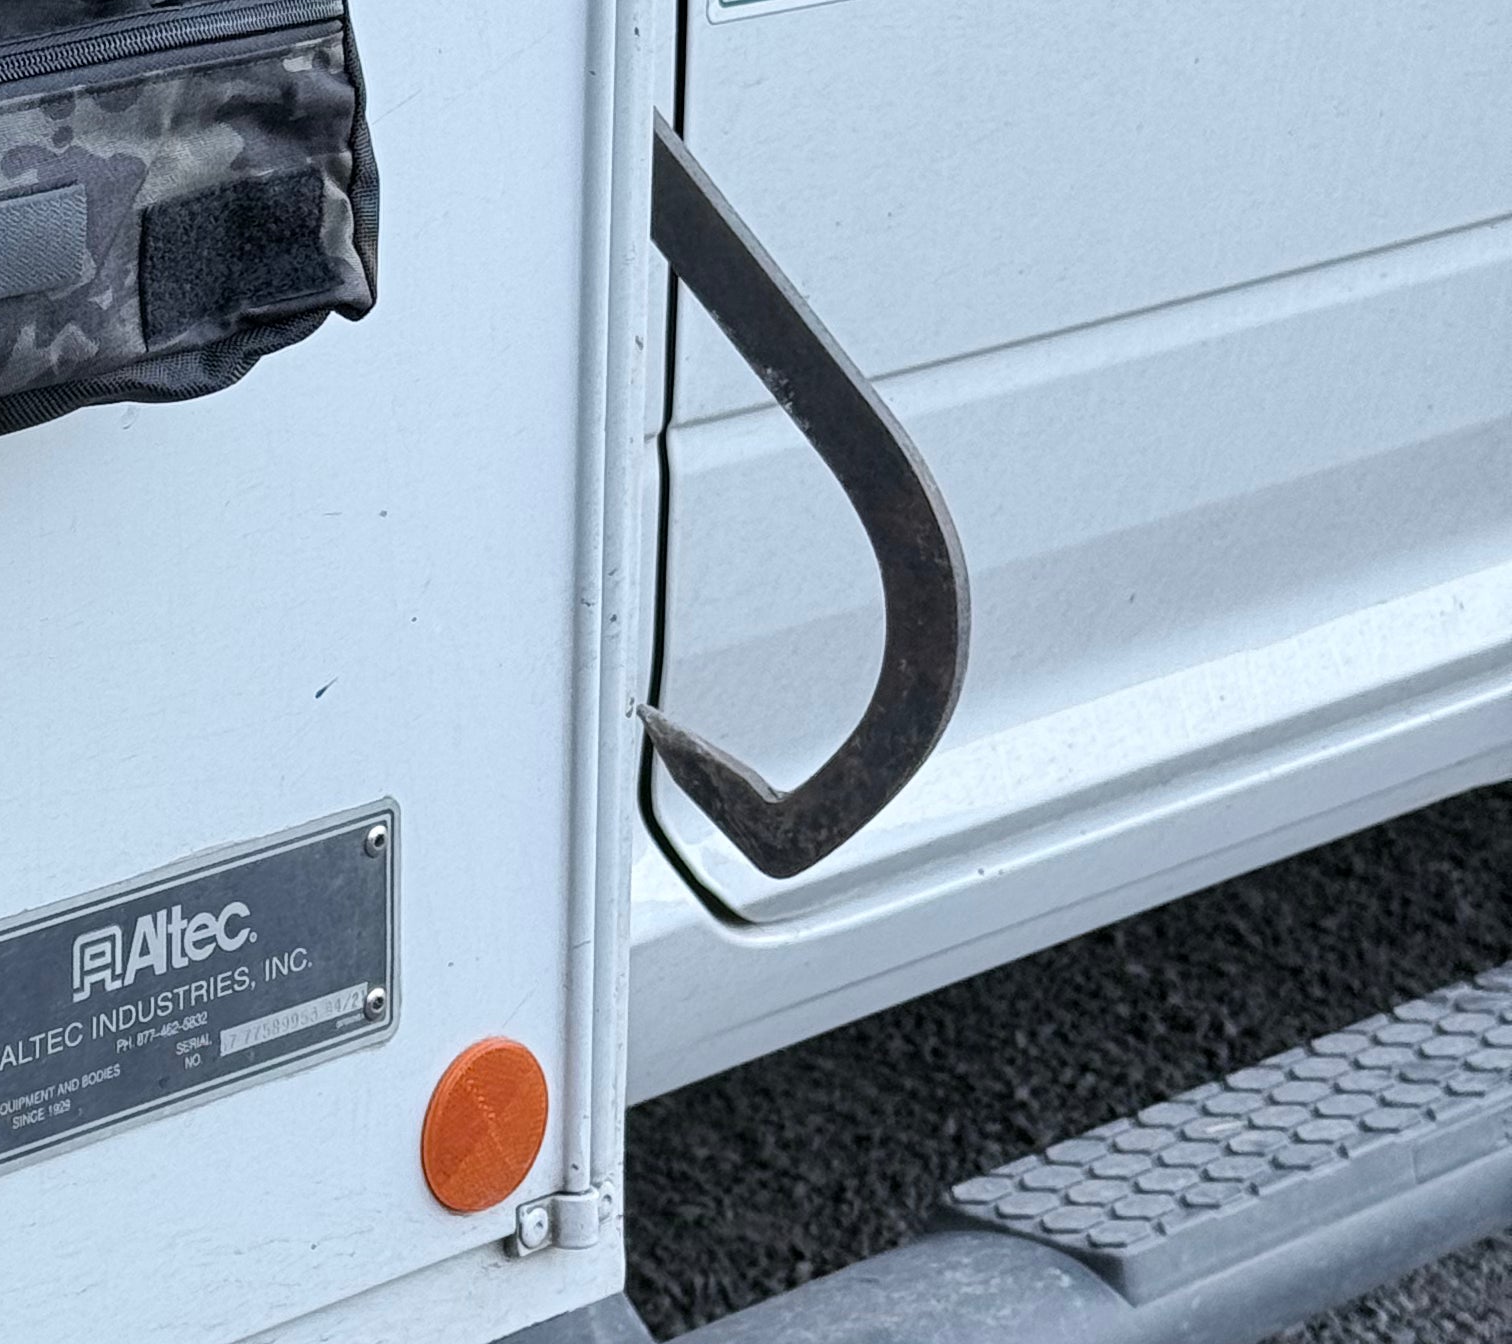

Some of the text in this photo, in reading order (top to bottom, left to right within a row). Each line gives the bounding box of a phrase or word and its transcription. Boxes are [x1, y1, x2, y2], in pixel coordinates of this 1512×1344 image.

[123, 901, 257, 986] Altec
[0, 947, 313, 1071] ALTEC INDUSTRIES, INC.
[57, 1078, 80, 1096] AND
[82, 1064, 121, 1088] BODIES
[12, 1108, 45, 1129] SINCE
